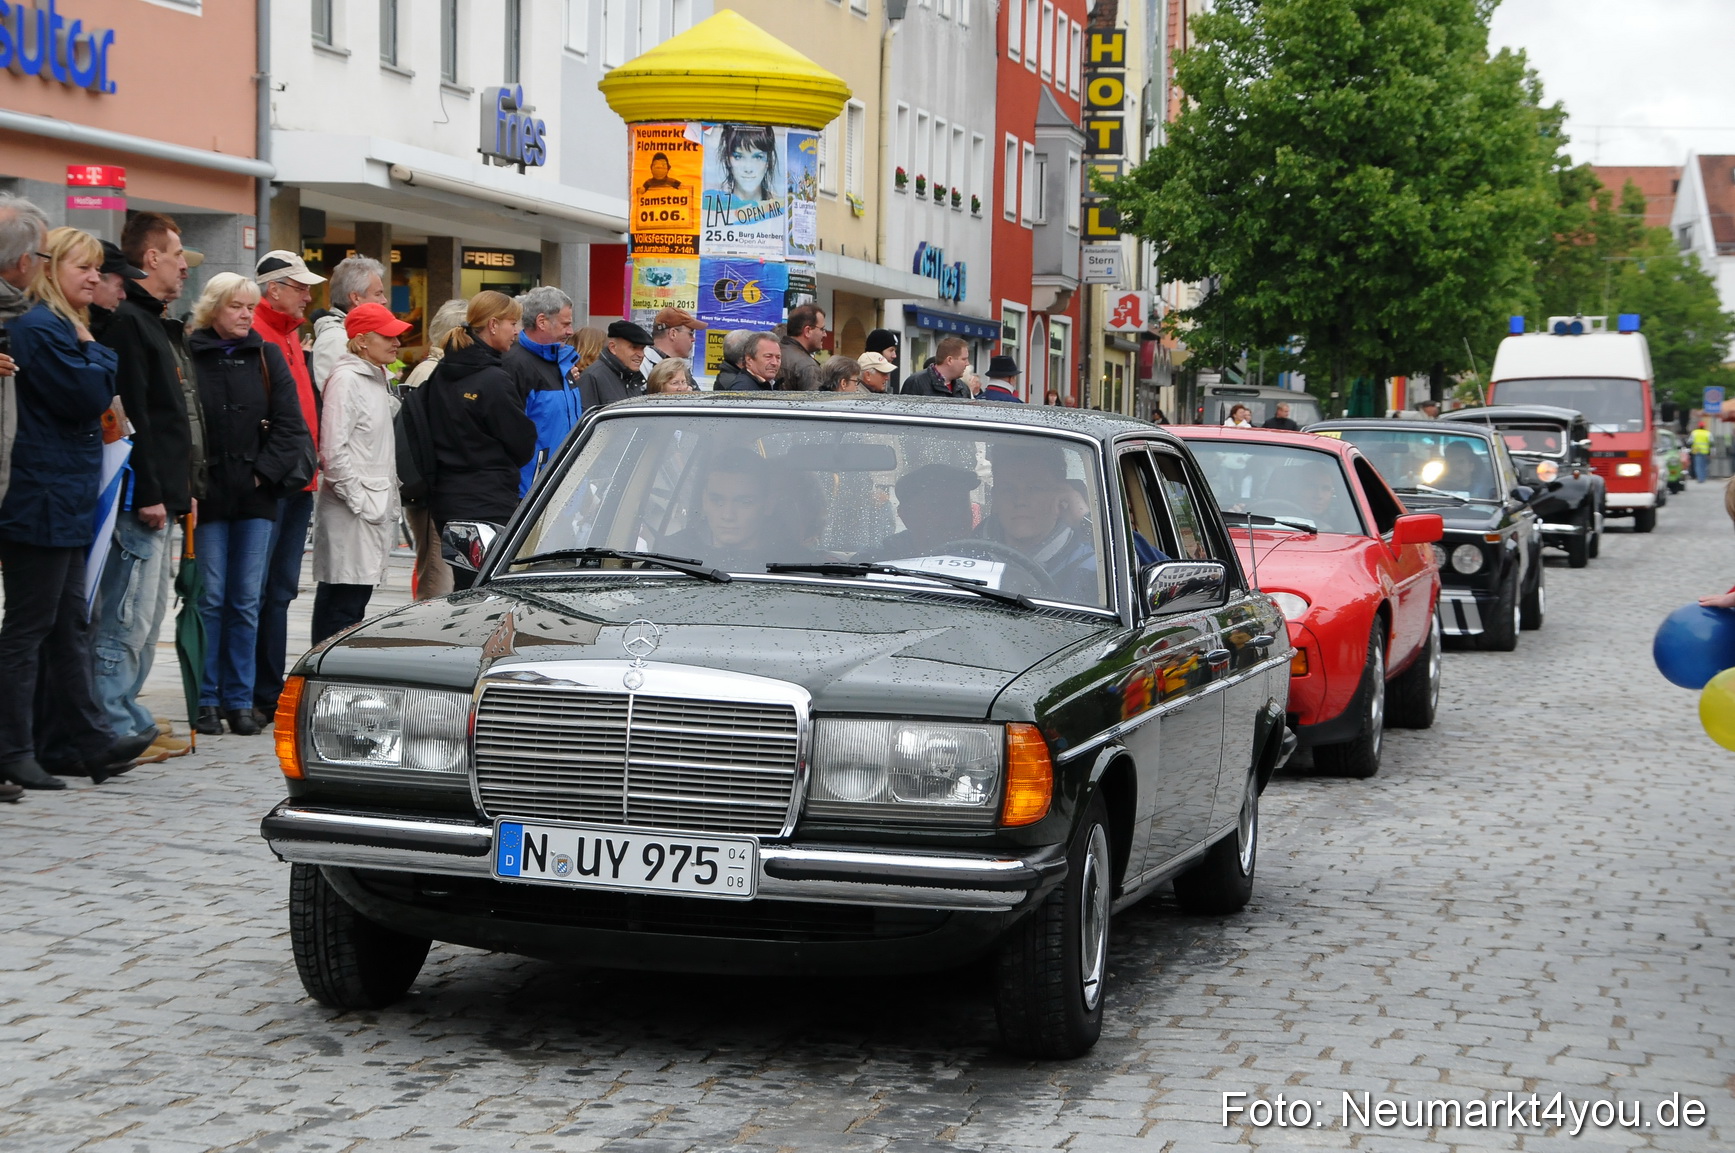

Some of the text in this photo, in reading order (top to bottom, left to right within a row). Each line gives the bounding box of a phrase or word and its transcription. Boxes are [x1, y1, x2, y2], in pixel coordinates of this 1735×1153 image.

[636, 128, 685, 138] Neumarkt
[1088, 34, 1124, 236] HOTEL
[637, 141, 699, 152] Flohmarkt
[640, 195, 688, 207] Samstag
[640, 210, 685, 222] 01.06.
[705, 193, 733, 228] ZAZ
[738, 206, 766, 224] OPEN
[768, 201, 783, 218] AIR
[634, 233, 693, 245] Volksfestplatz
[705, 230, 739, 242] 25.6.
[739, 231, 754, 239] Burg
[464, 251, 515, 266] FRIES
[1088, 256, 1114, 265] Stern
[713, 278, 761, 304] G6
[632, 299, 695, 310] Sonntag, 2. Juni 2013
[934, 559, 976, 568] 159
[522, 832, 720, 885] N UY 975
[728, 848, 746, 860] 04
[505, 855, 514, 866] D
[726, 875, 744, 887] 08
